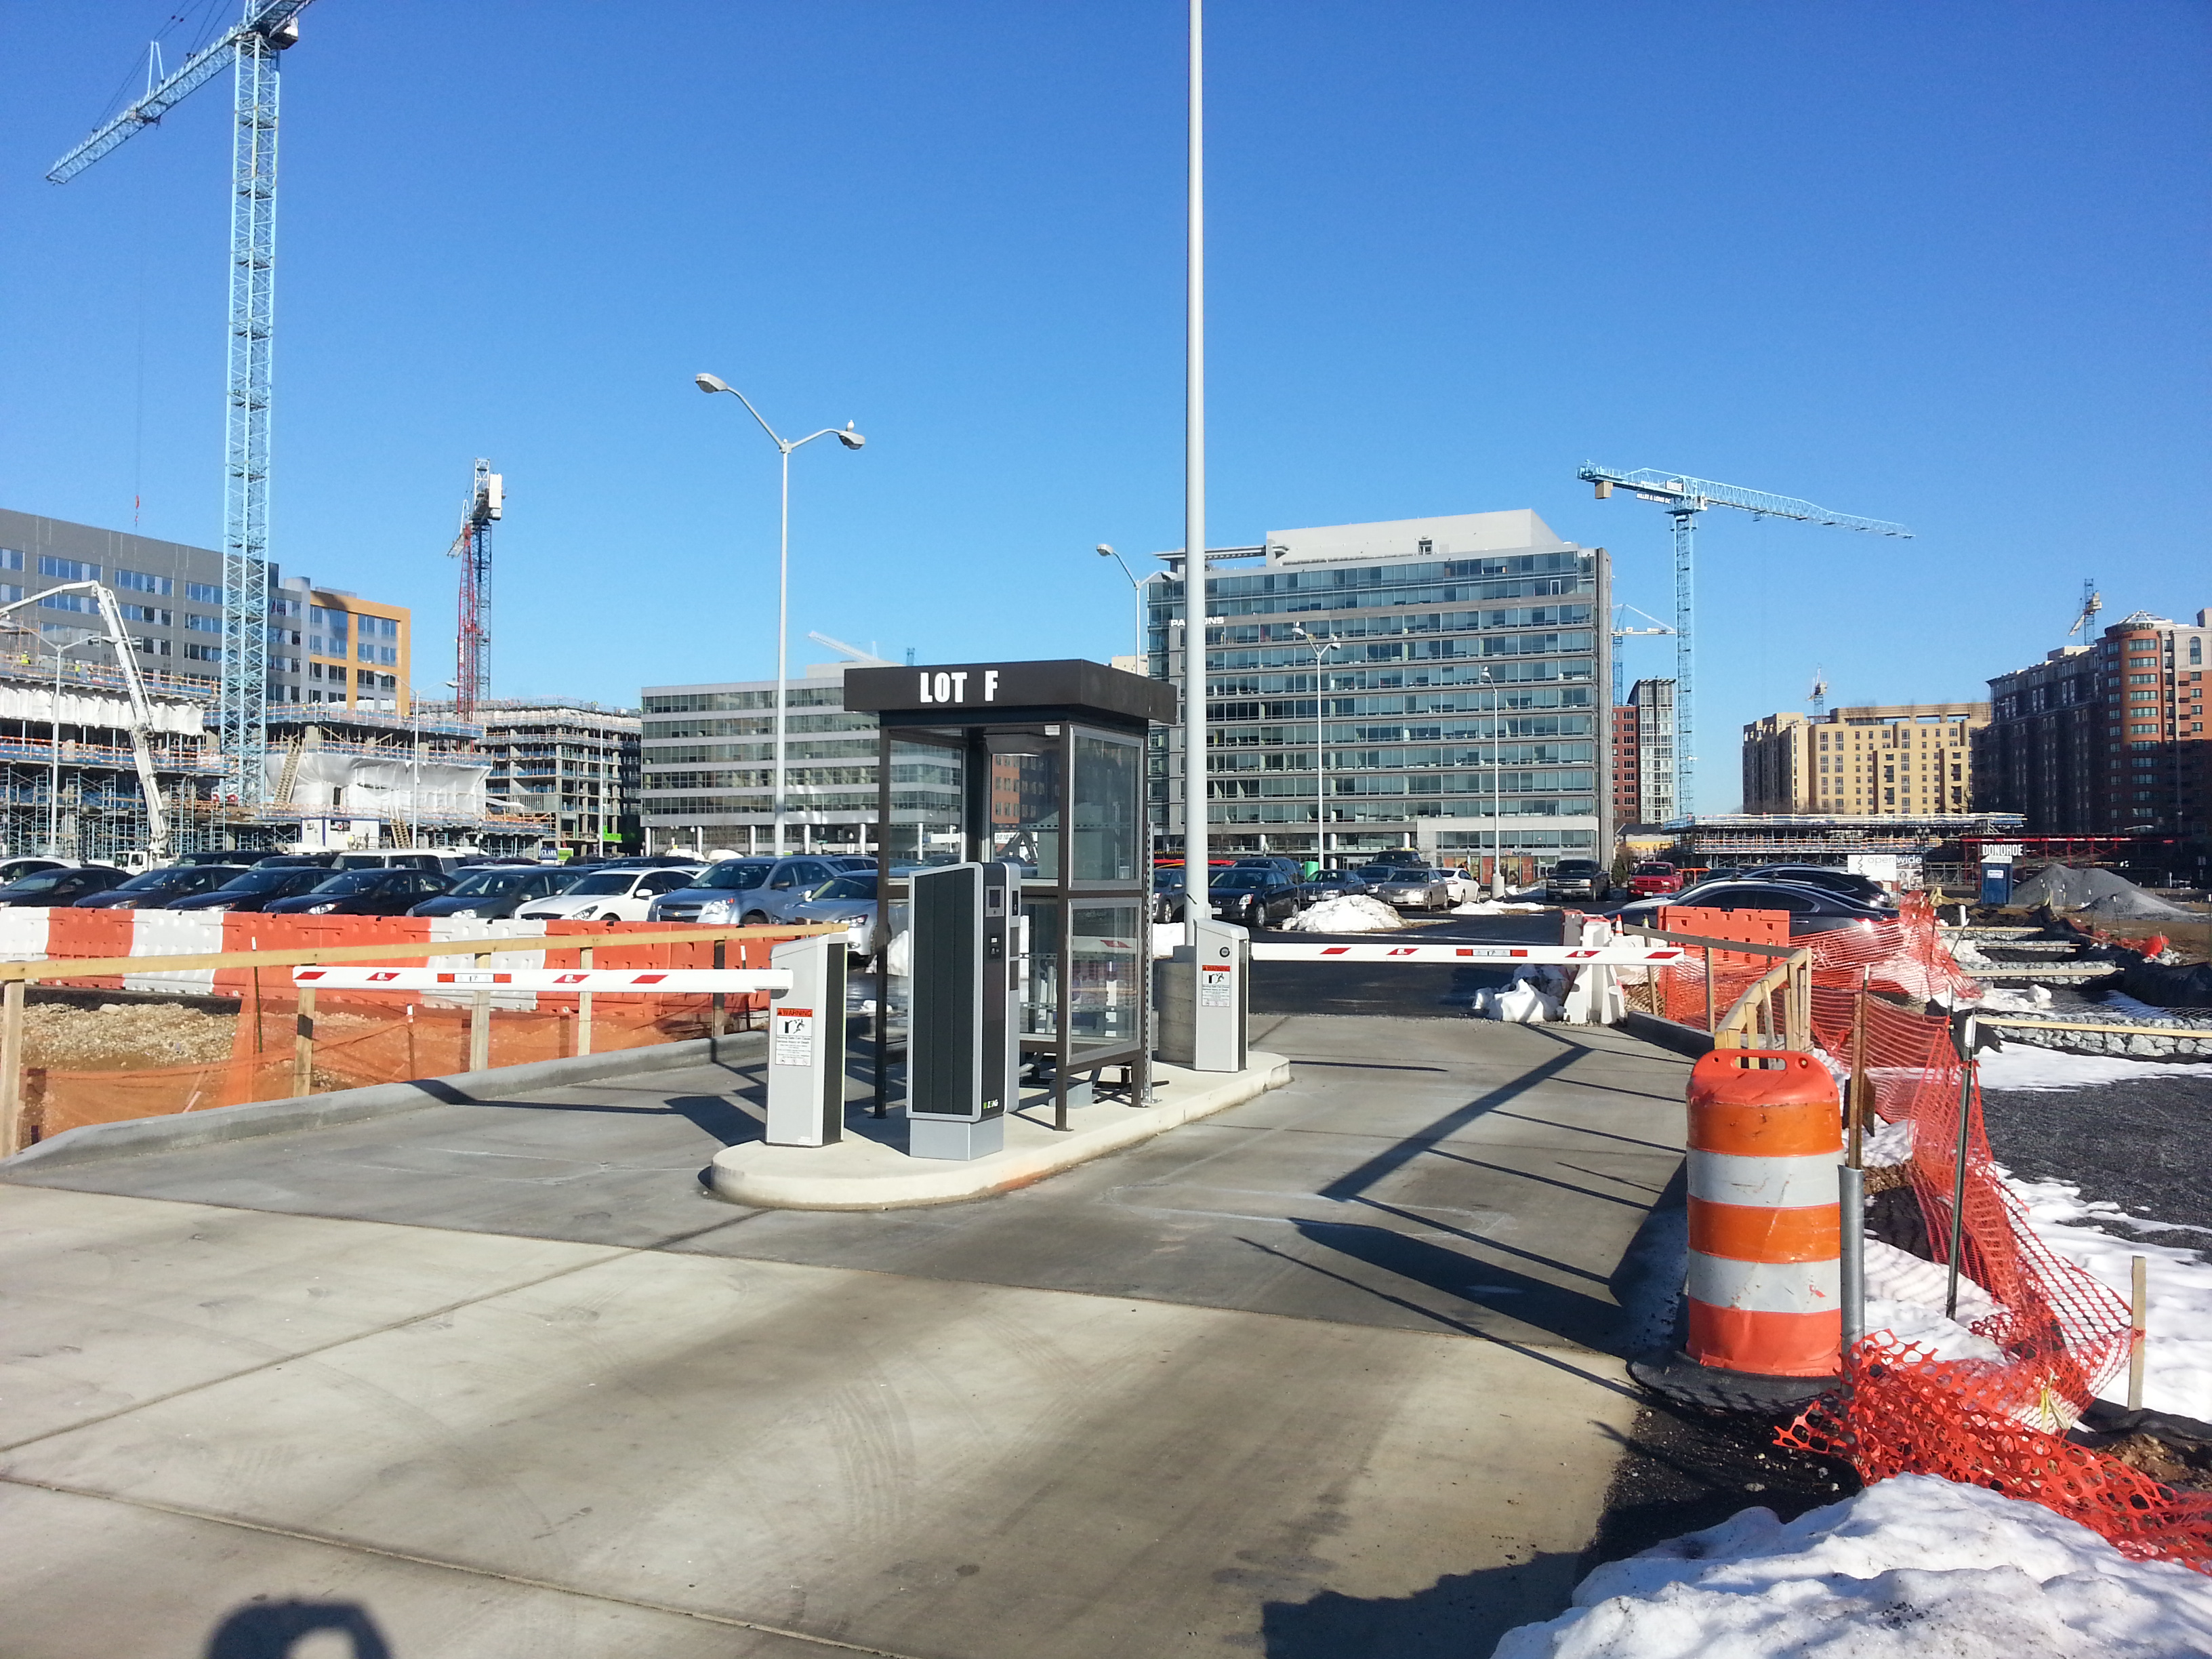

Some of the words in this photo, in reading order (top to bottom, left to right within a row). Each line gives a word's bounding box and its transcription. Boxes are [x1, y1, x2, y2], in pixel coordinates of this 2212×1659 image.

[1170, 617, 1224, 627] PANS
[920, 672, 968, 703] LOT
[985, 670, 998, 701] F
[1982, 844, 2023, 855] DONOHOE
[1868, 857, 1895, 866] open
[1896, 855, 1922, 863] wide
